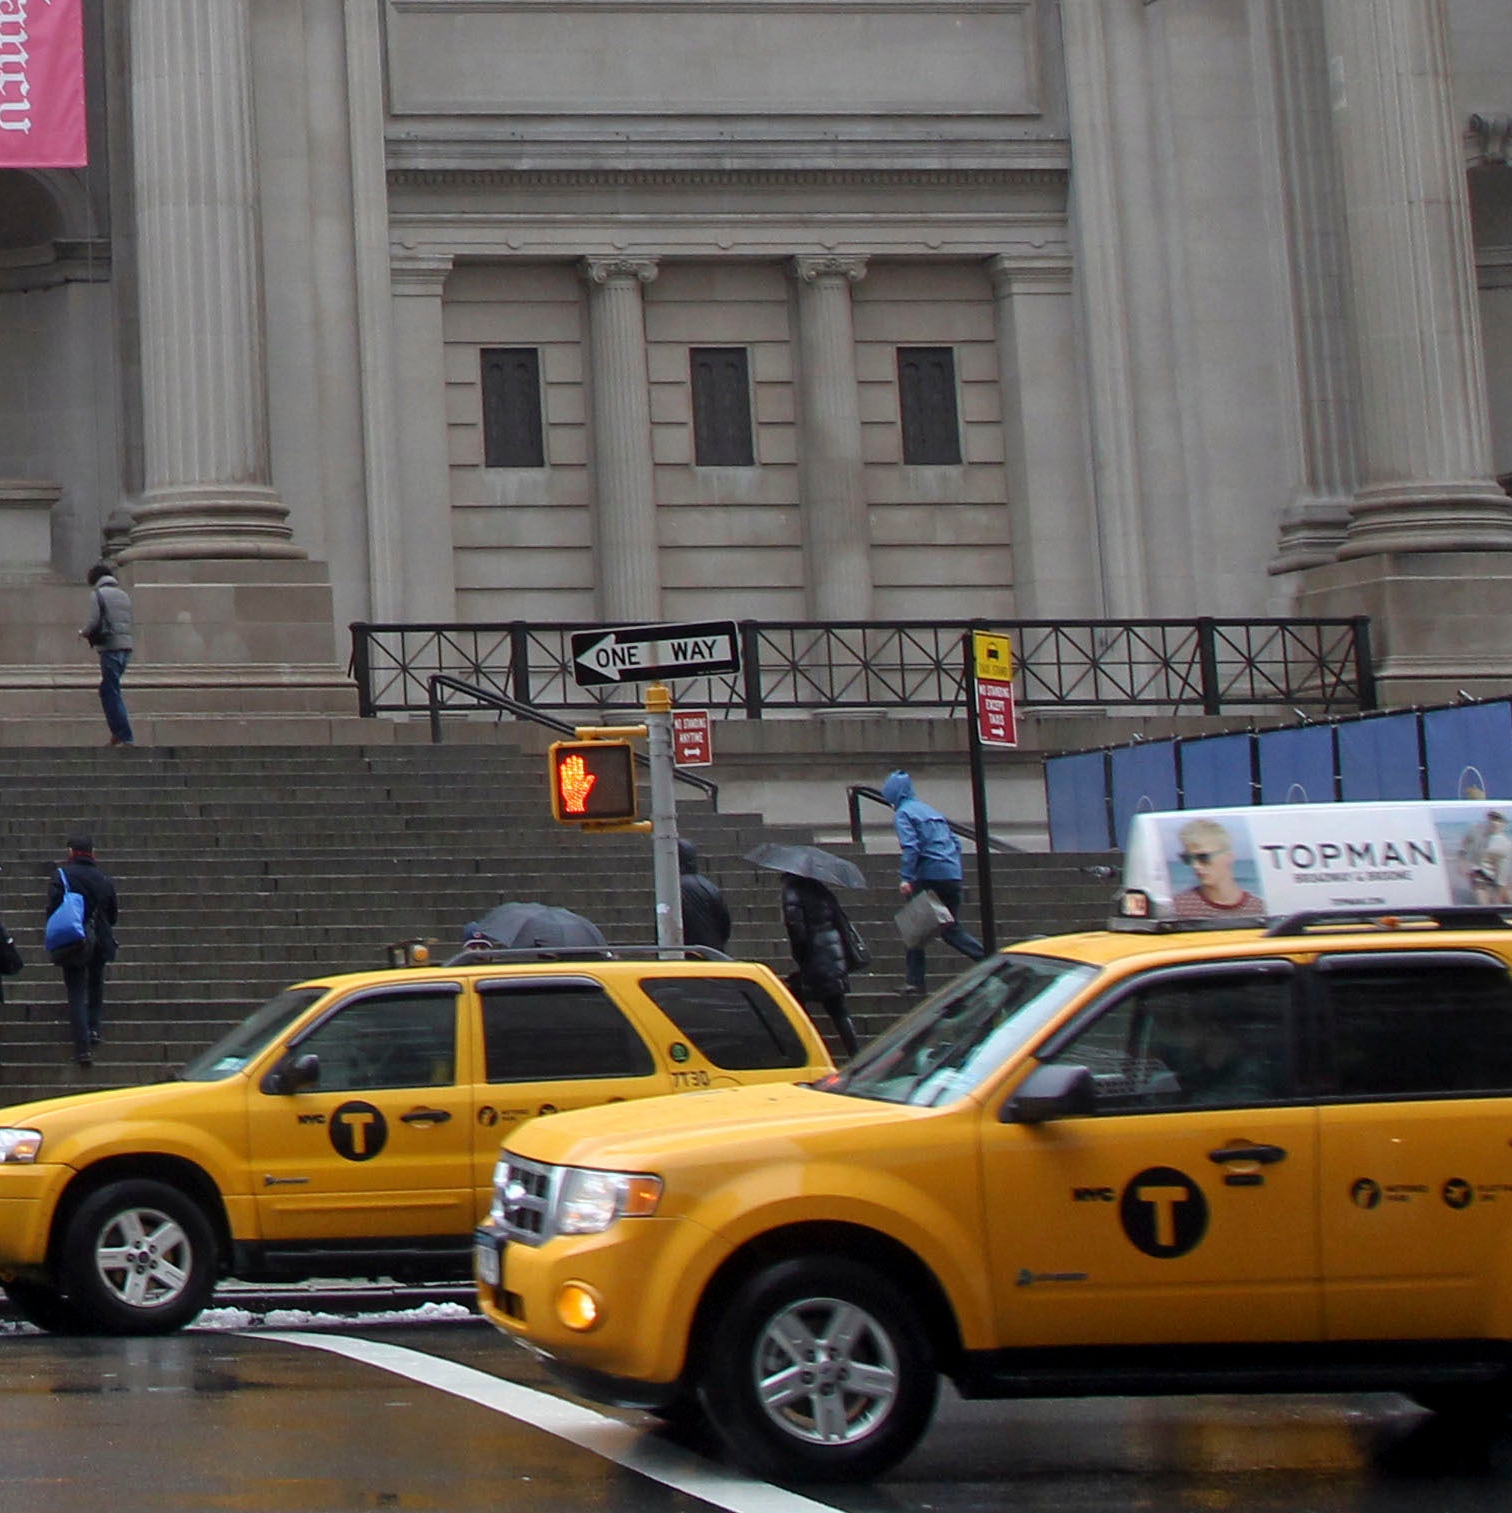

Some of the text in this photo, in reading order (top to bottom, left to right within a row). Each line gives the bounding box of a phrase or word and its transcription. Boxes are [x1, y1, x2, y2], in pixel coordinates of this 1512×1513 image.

[595, 639, 718, 668] ONE WAY
[1260, 839, 1438, 870] TOPMAN
